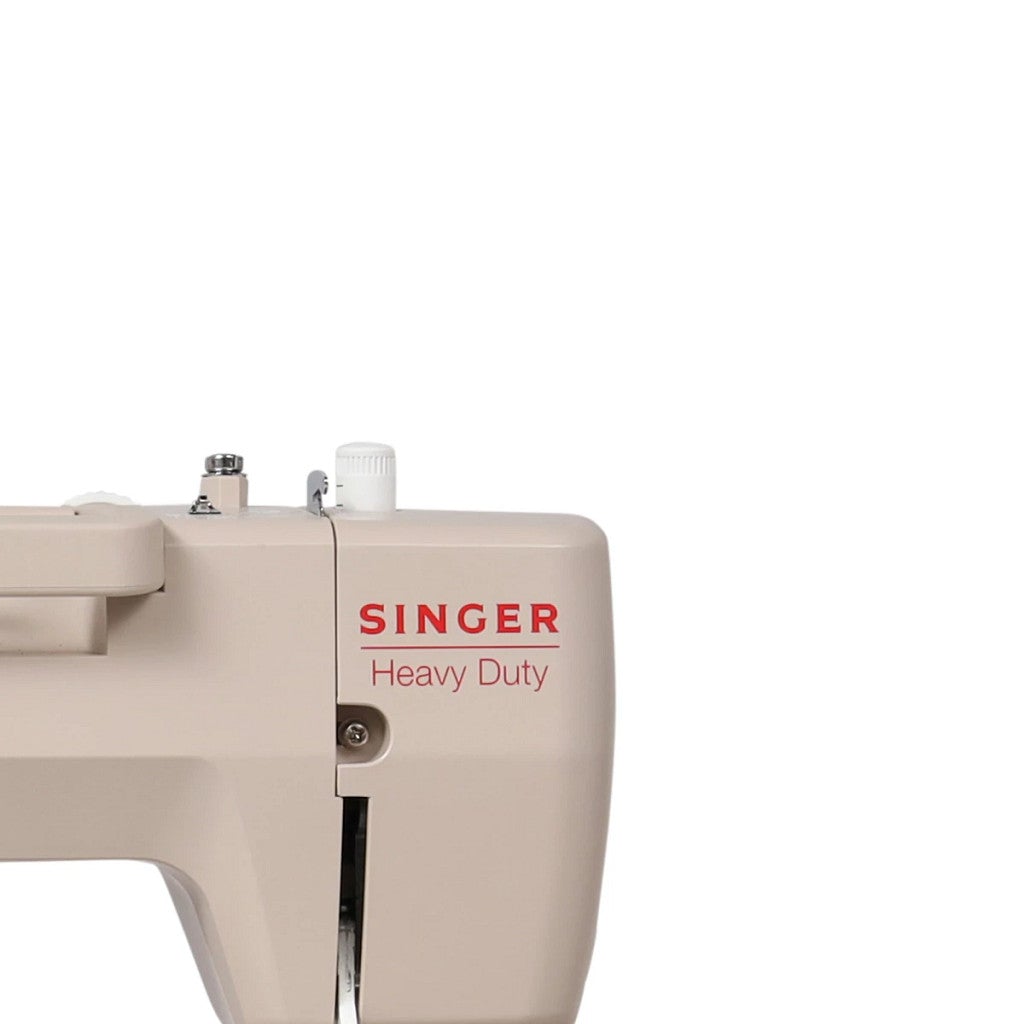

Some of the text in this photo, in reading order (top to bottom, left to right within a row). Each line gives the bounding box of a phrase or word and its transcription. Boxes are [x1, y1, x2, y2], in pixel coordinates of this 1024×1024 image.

[359, 603, 560, 635] SINGER
[371, 658, 549, 693] Heavy Duty
